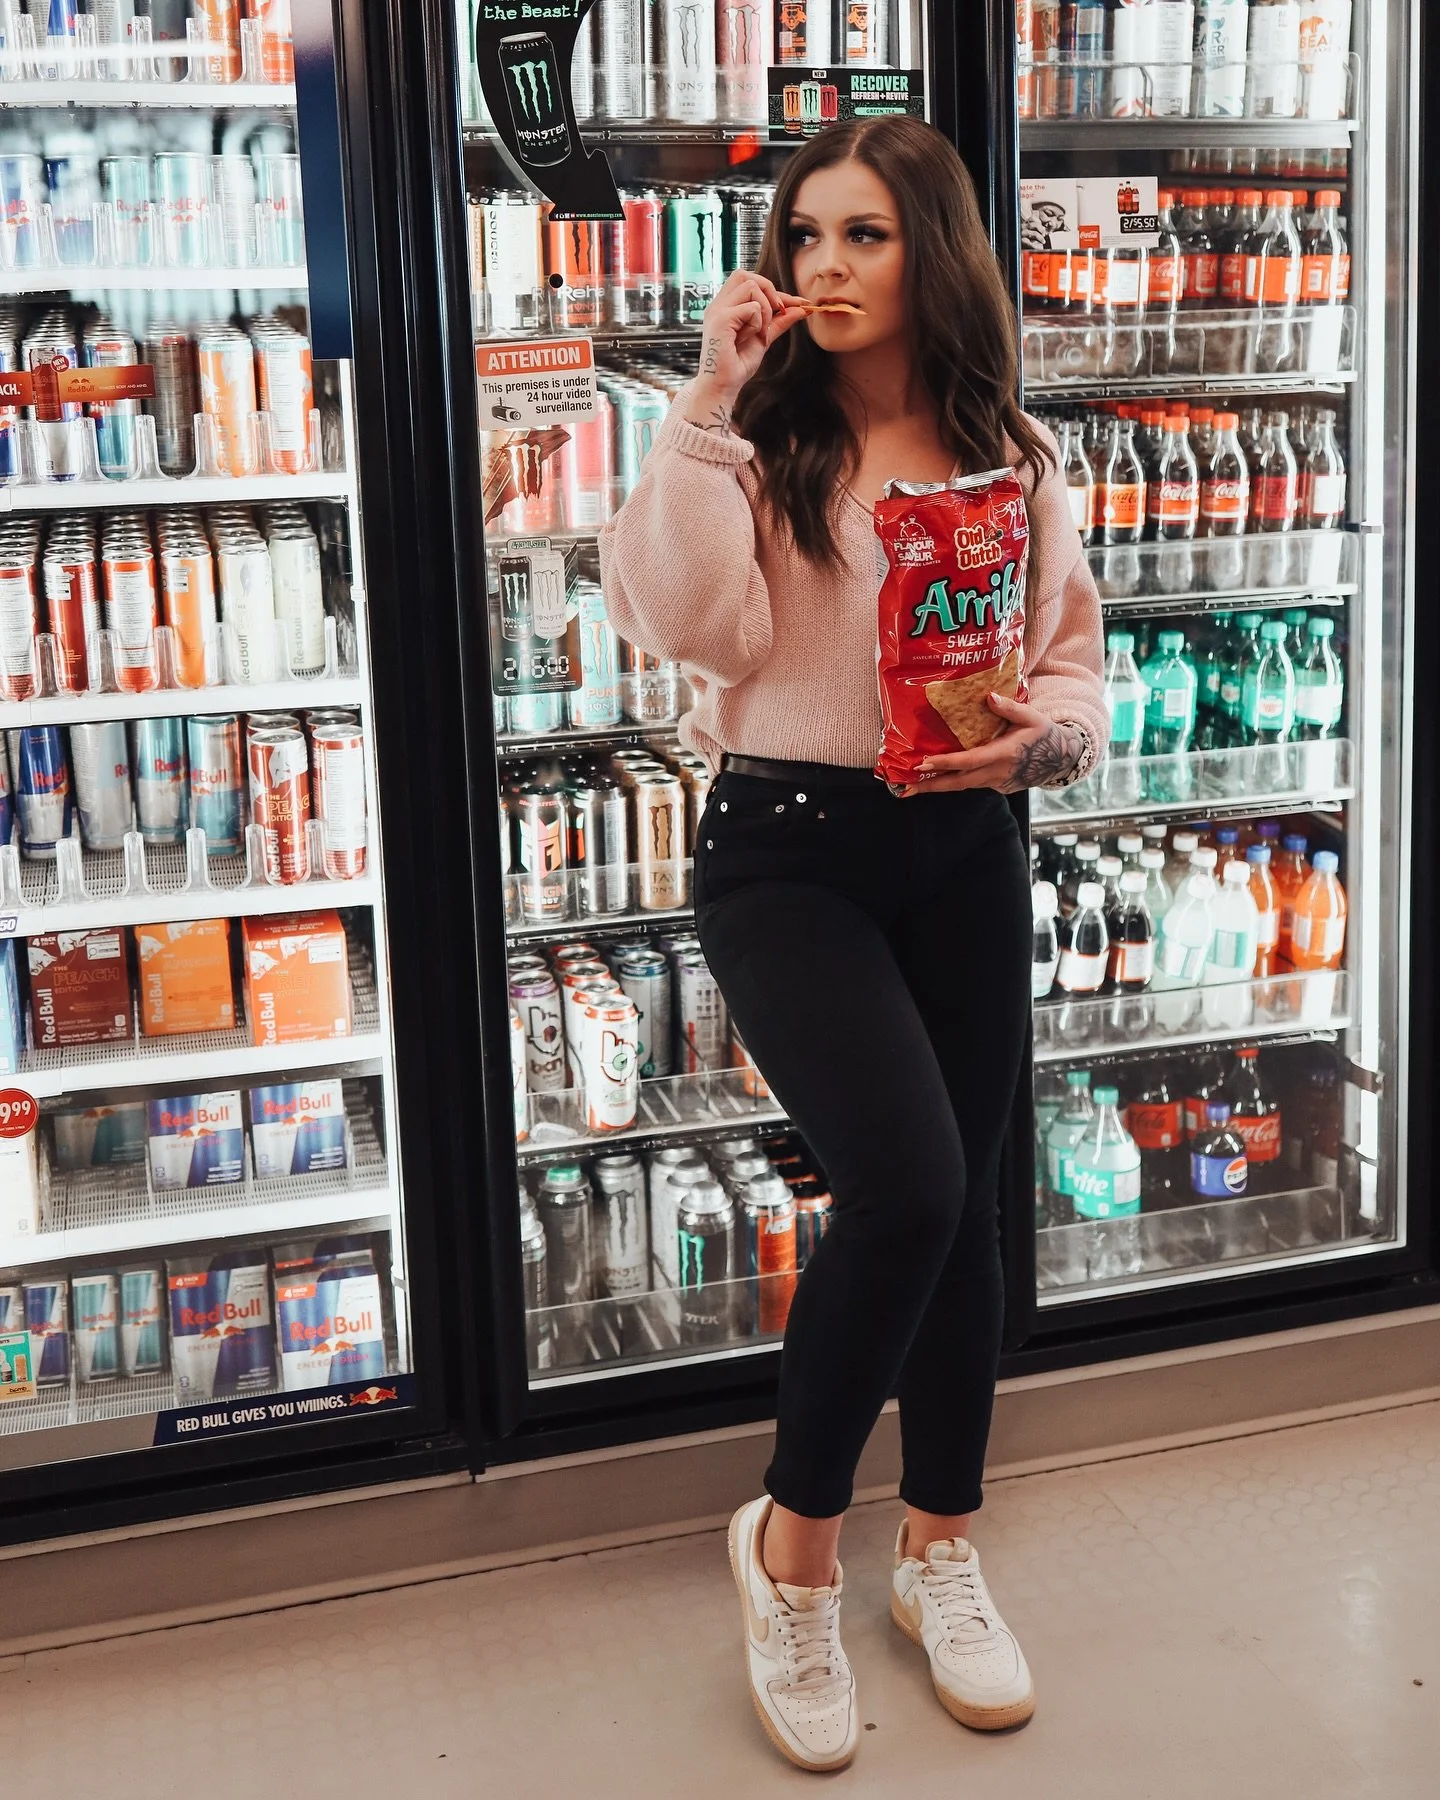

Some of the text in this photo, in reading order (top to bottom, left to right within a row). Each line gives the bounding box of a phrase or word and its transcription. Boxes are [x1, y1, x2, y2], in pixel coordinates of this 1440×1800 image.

[484, 0, 579, 20] the Beast!
[813, 70, 826, 78] NEW
[850, 75, 909, 92] RECOVER
[517, 123, 566, 141] MONSTER
[525, 136, 563, 147] ENERGY
[1123, 217, 1155, 229] 2/$5.50
[487, 346, 581, 371] ATTENTION
[703, 338, 721, 374] 1998
[0, 383, 21, 396] ACH.
[482, 376, 590, 394] This premises is under
[526, 388, 591, 402] 24 hour video
[535, 401, 593, 414] surveillance
[893, 540, 936, 551] FLAVOUR
[956, 528, 985, 548] Old
[898, 551, 934, 562] SAVEUR
[958, 543, 1002, 570] Dutch
[911, 562, 1021, 636] Arrib
[948, 632, 993, 649] SWEET
[942, 650, 990, 666] PIMENT
[32, 938, 40, 946] 4
[53, 967, 119, 987] PEACH
[54, 985, 88, 995] EDITION
[147, 973, 165, 1023] Bull Red
[257, 992, 276, 1018] Bull
[36, 988, 57, 1043] Bull Red
[264, 1092, 331, 1116] Red Bull
[161, 1105, 229, 1128] Red Bull
[176, 1277, 184, 1287] 4
[284, 1288, 293, 1298] 4
[181, 1298, 261, 1327] Red Bull
[290, 1311, 372, 1342] Red Bull
[176, 1394, 348, 1433] RED BULL GIVES YOU WIIINGS.
